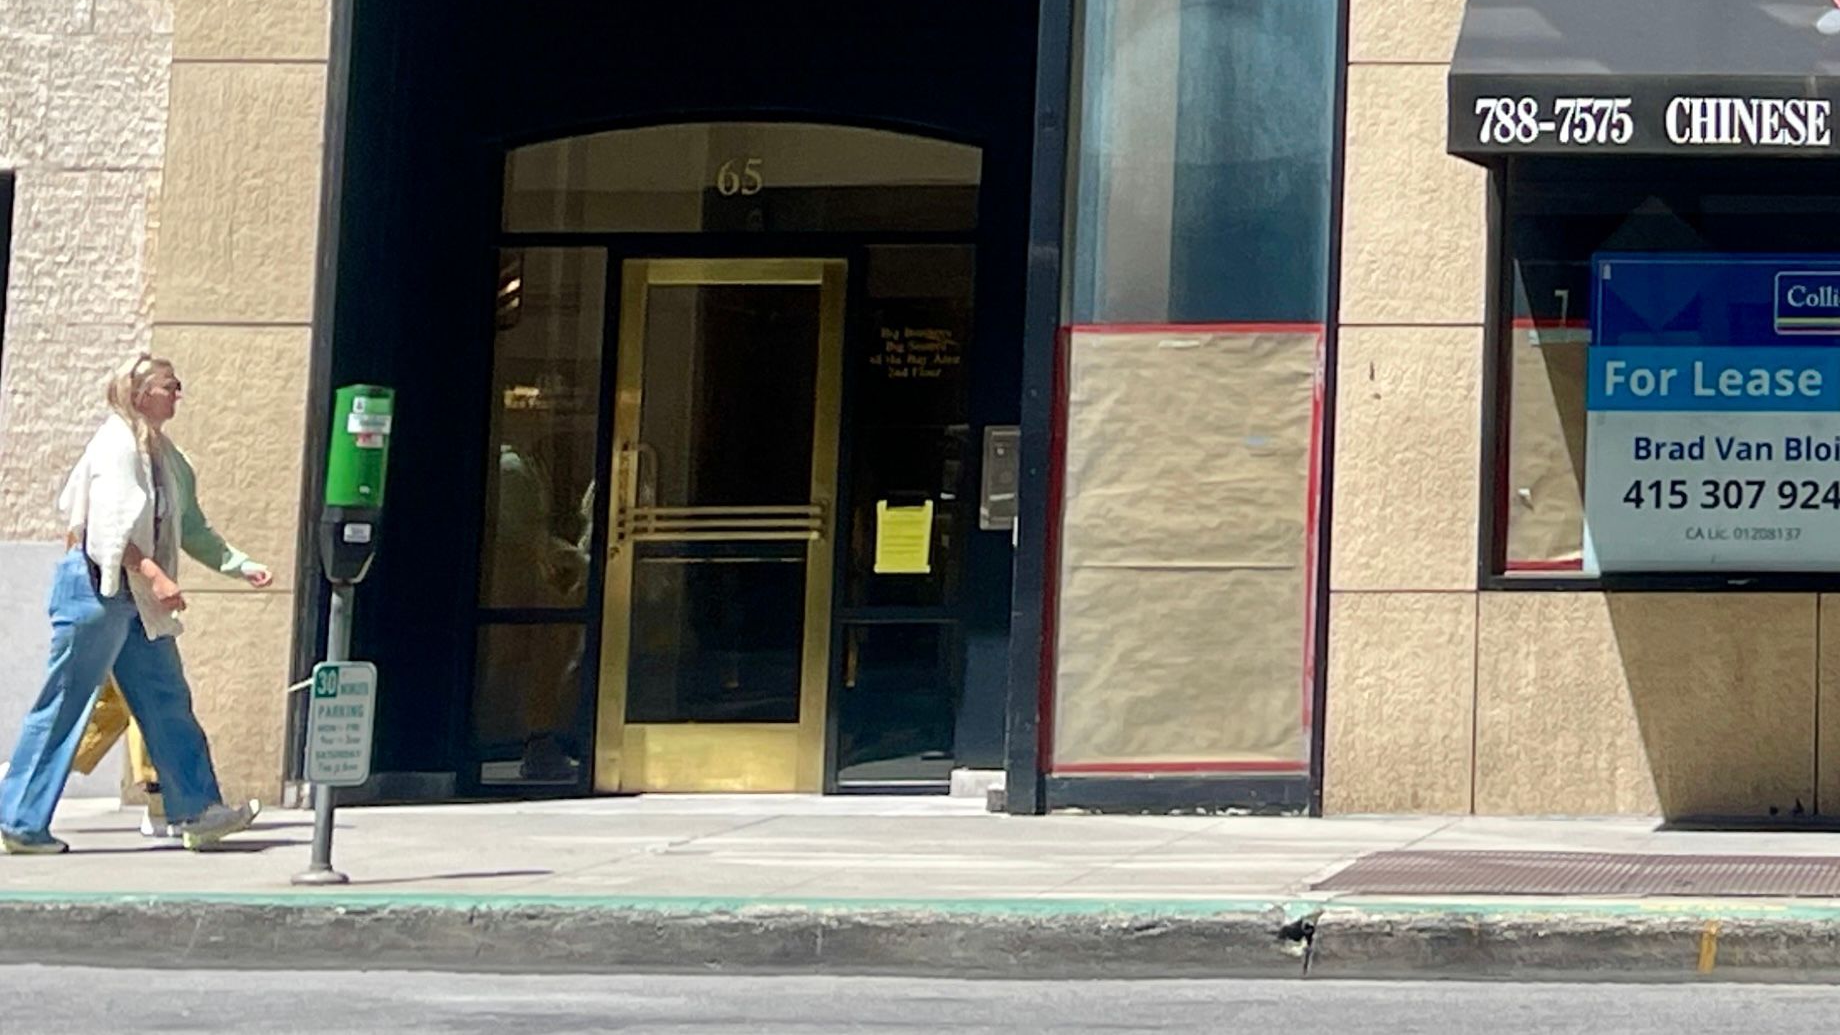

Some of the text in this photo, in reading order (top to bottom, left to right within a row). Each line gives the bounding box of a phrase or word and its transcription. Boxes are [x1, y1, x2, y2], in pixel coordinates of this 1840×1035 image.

[1475, 97, 1634, 144] 788-7575
[1665, 97, 1831, 146] CHINESE
[717, 157, 764, 196] 65
[1604, 361, 1822, 396] For Lease
[1634, 436, 1705, 461] Brad
[1714, 436, 1773, 461] Van
[1623, 479, 1688, 510] 415
[1700, 479, 1766, 510] 307
[1685, 526, 1705, 541] CA
[317, 669, 337, 695] 30
[318, 705, 364, 718] PARKING
